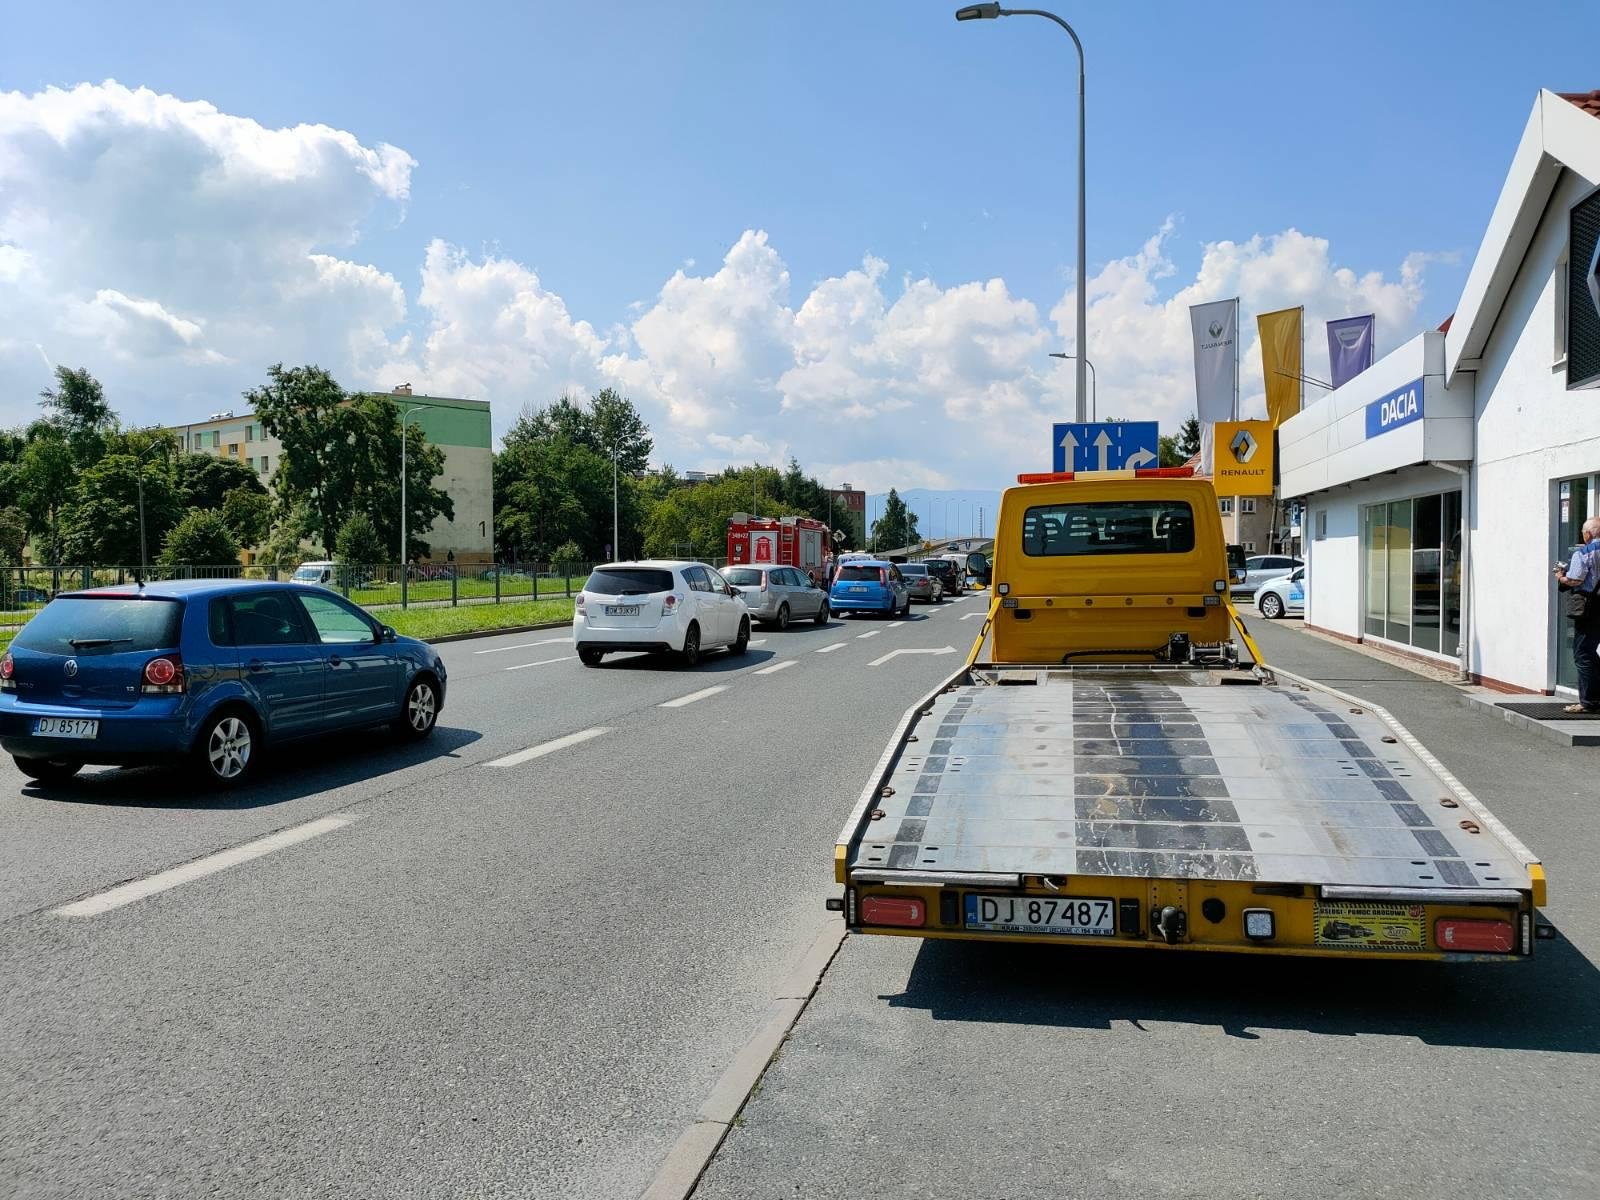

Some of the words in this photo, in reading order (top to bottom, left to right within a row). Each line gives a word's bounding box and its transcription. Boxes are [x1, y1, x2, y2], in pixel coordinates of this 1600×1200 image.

[1381, 389, 1418, 427] DACIA
[478, 520, 486, 537] 1
[40, 719, 55, 732] DJ
[59, 719, 96, 734] 85171
[982, 898, 1015, 923] DJ
[1028, 901, 1110, 926] 87487
[1372, 909, 1406, 917] DROGOWA
